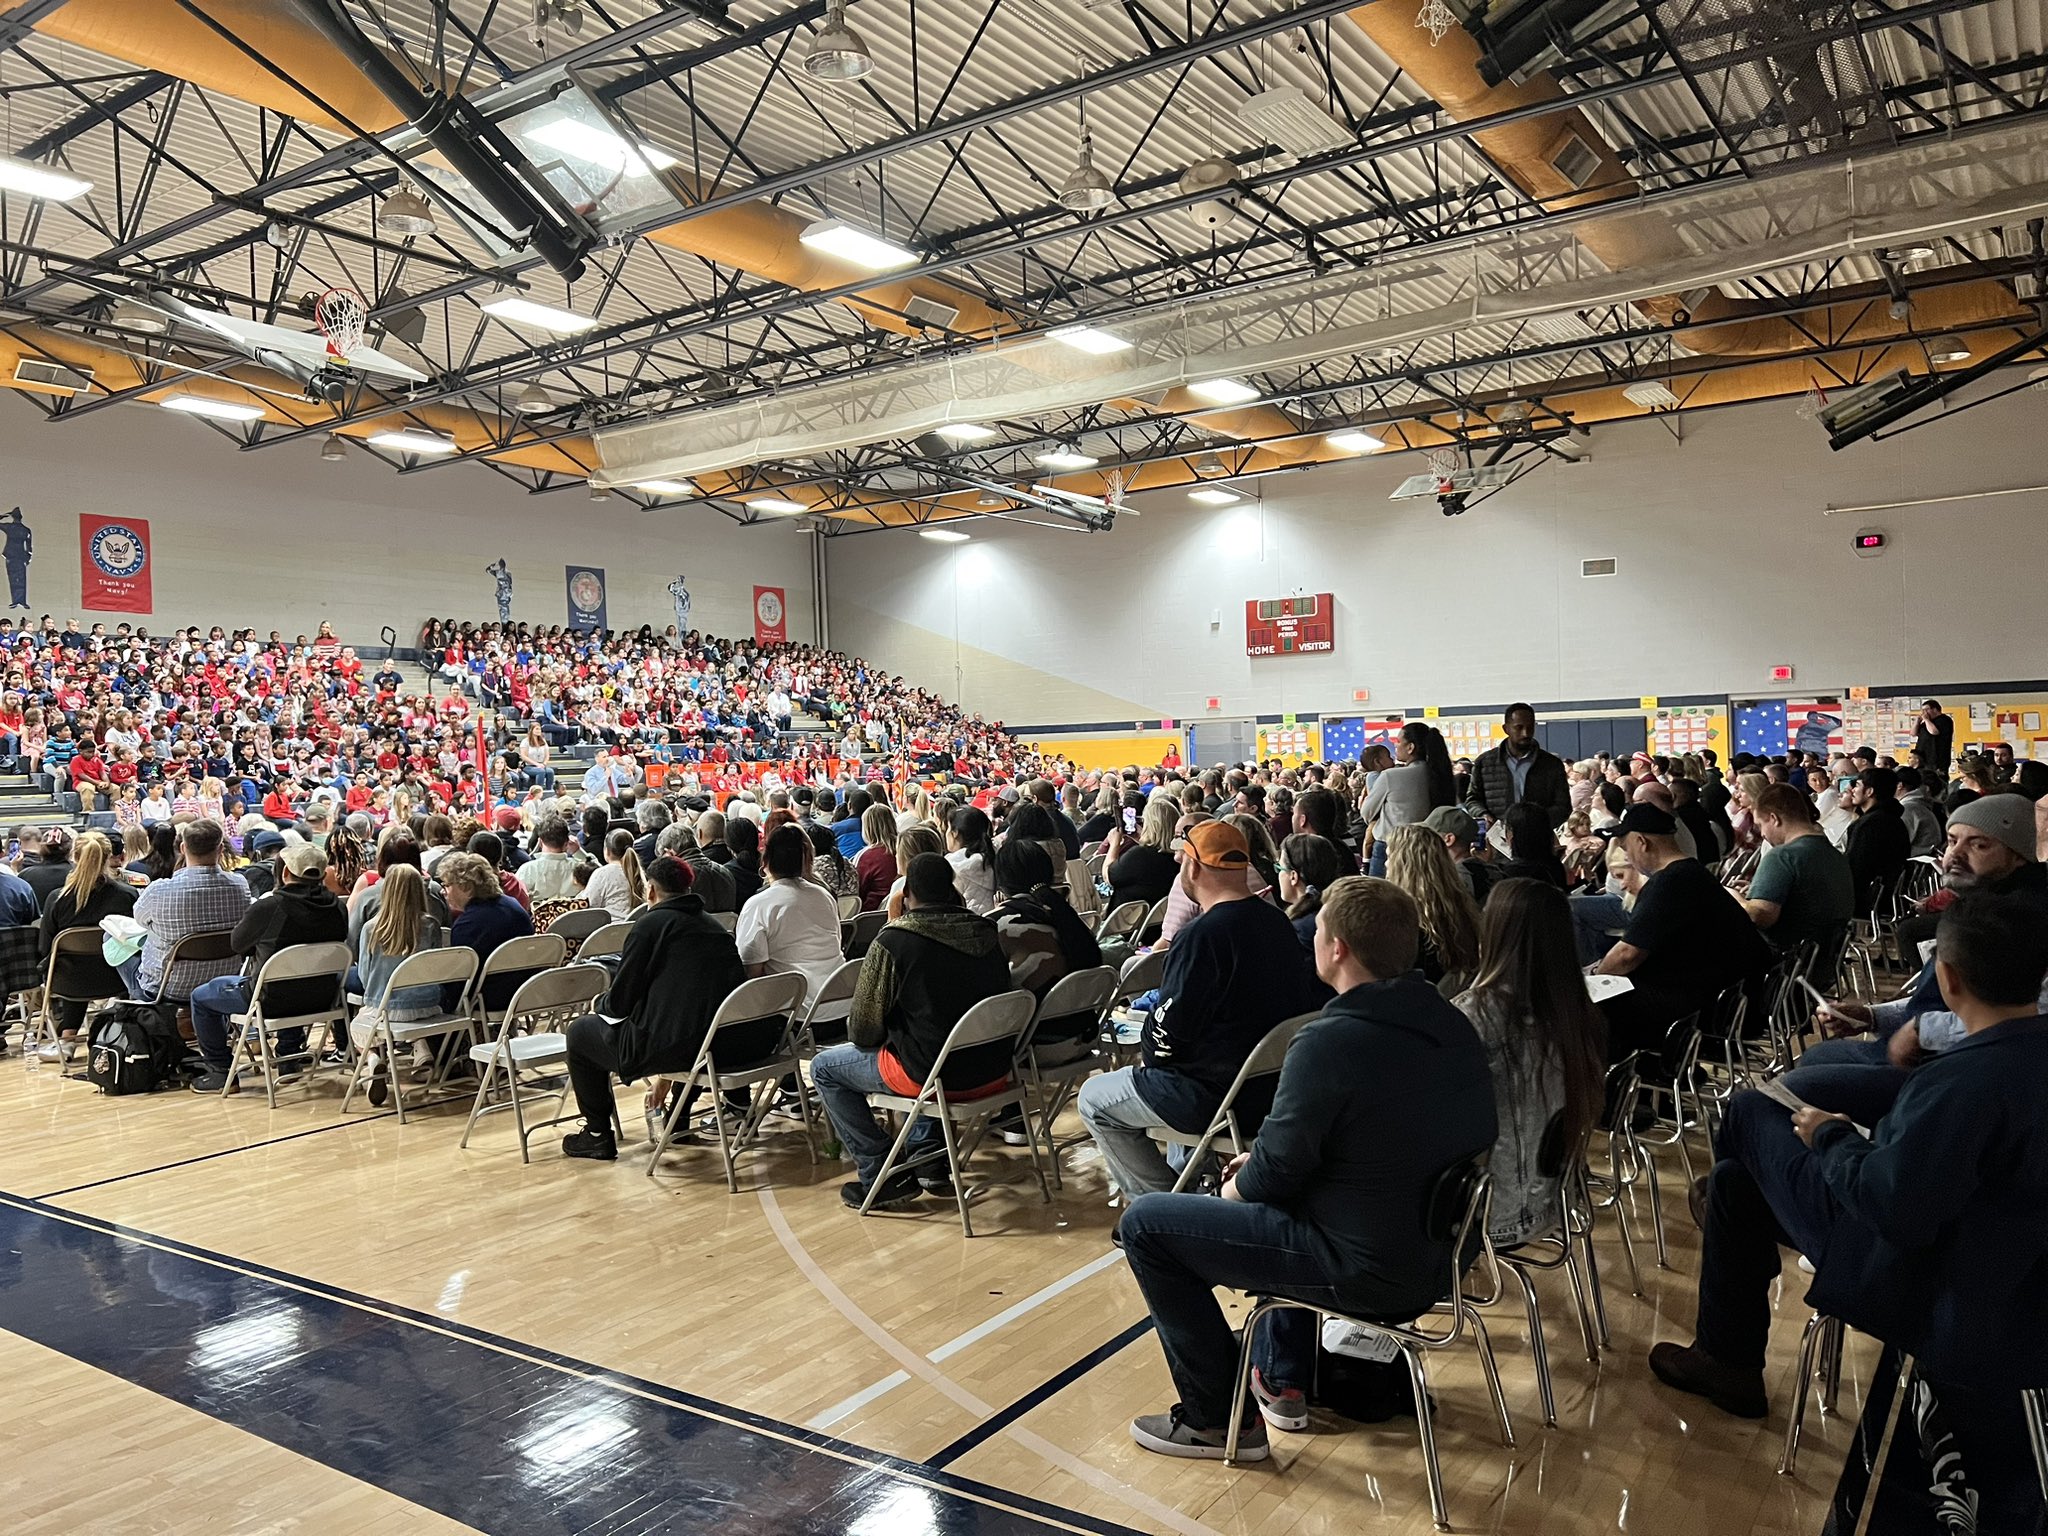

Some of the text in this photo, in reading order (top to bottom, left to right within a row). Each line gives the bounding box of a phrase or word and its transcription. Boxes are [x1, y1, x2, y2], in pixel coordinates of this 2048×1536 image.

[93, 528, 142, 563] UNITED STATES
[104, 564, 133, 575] NAVY
[98, 579, 119, 587] Thank
[1248, 641, 1331, 655] HOME VISITOR
